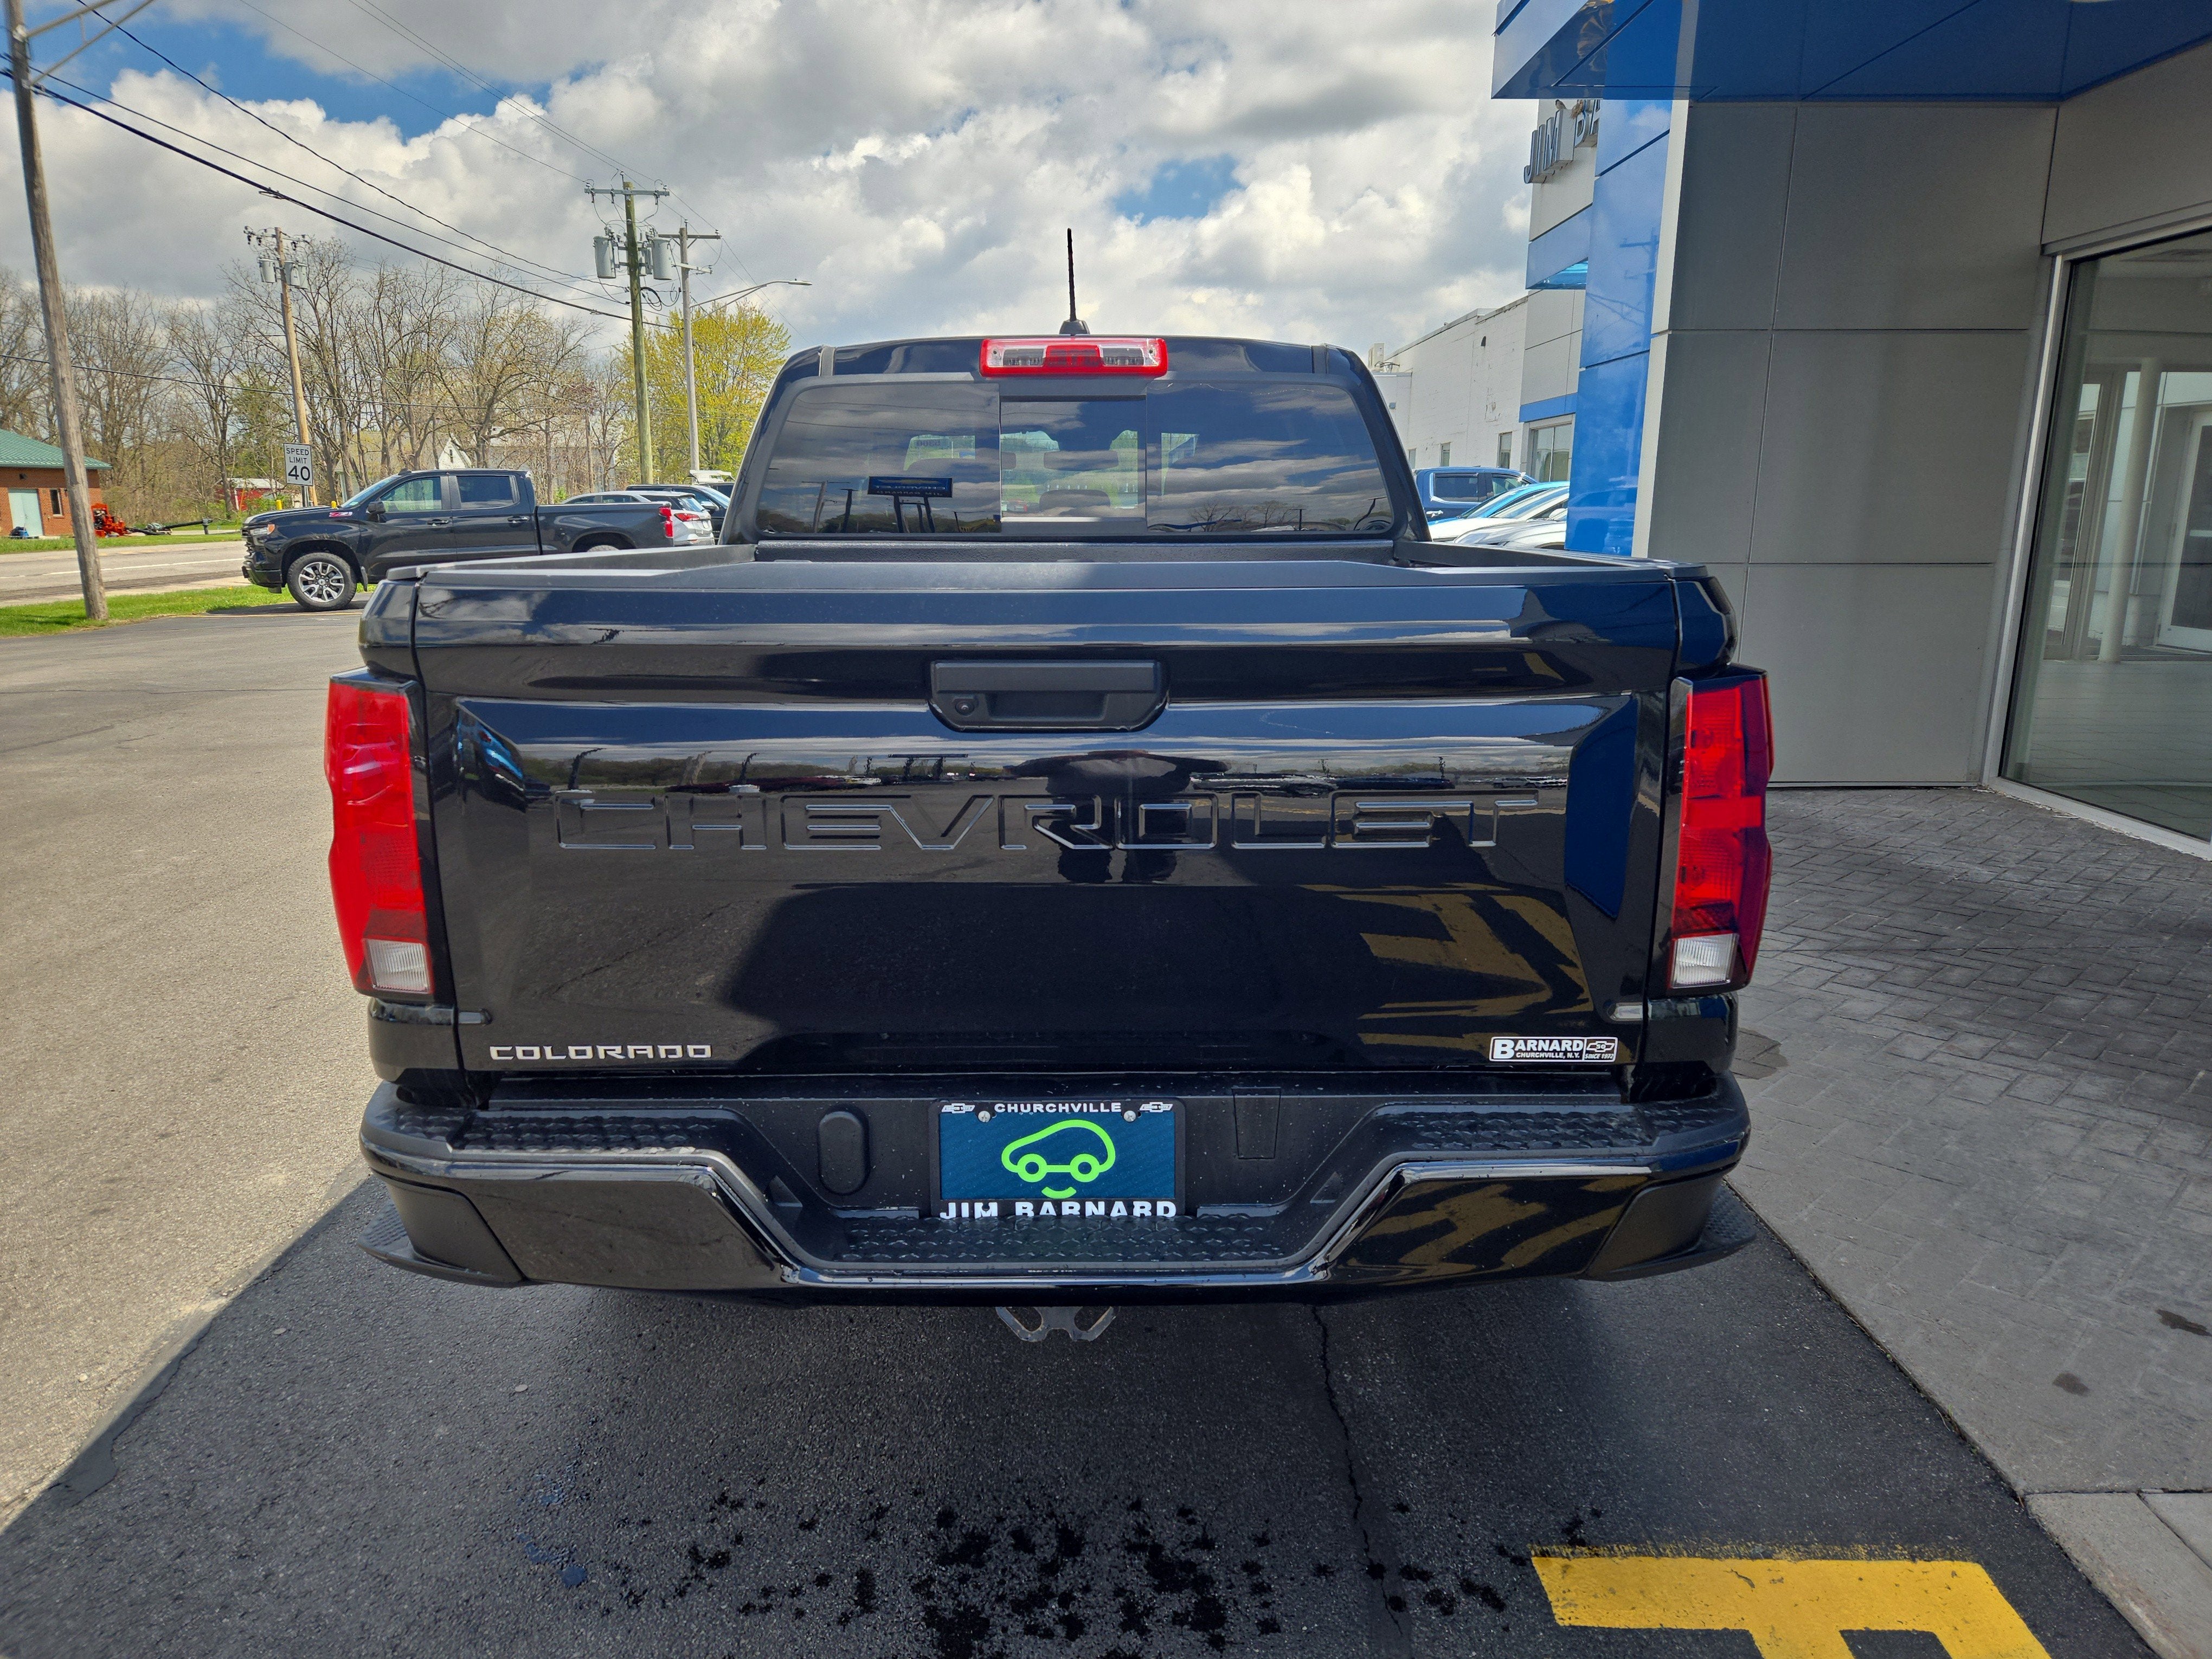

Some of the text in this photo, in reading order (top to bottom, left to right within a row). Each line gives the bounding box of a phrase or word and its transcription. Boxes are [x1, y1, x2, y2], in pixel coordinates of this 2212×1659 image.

[1524, 109, 1566, 184] JIM
[288, 465, 310, 481] 40
[555, 789, 1539, 850] CHEVROLET
[490, 1045, 712, 1060] COLORADO
[1493, 1039, 1584, 1059] BARNARD
[994, 1103, 1122, 1113] CHURCHVILLE
[940, 1201, 1176, 1219] JIM BARNARD
